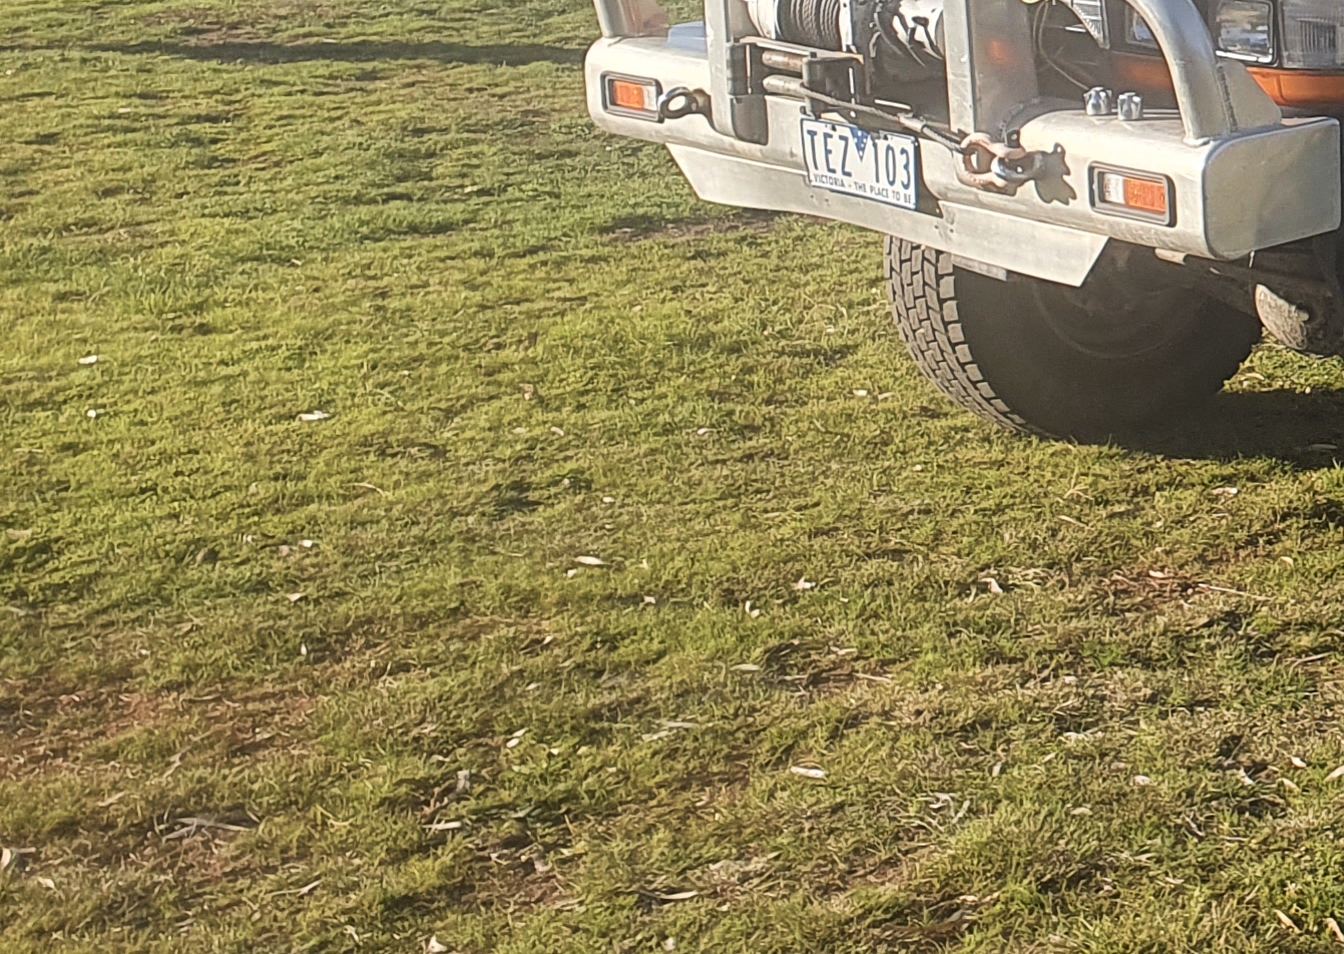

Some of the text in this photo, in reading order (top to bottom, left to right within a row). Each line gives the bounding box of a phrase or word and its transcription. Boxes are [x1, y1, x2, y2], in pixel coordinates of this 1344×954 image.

[806, 129, 911, 190] TEZ 103
[813, 173, 846, 188] VICTORIA
[854, 181, 867, 193] THE
[869, 185, 889, 199] PLACE
[892, 190, 901, 201] TO
[903, 194, 912, 204] BE
